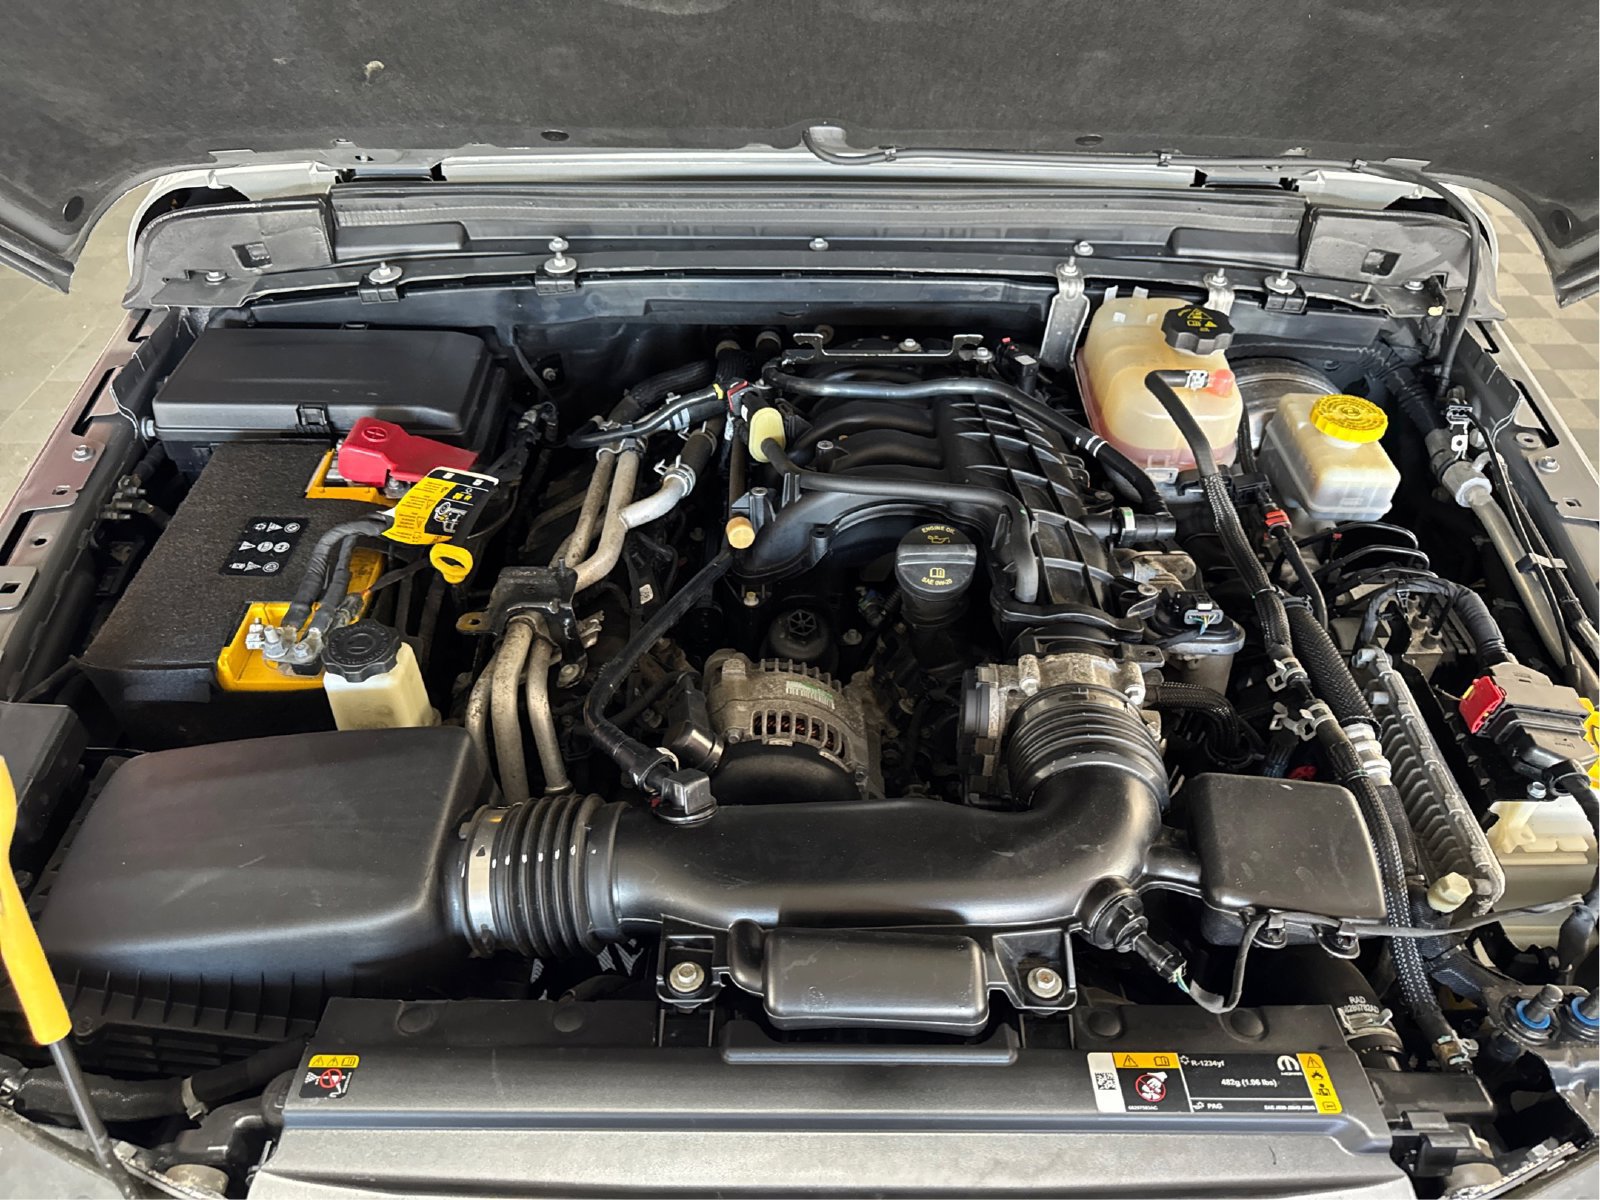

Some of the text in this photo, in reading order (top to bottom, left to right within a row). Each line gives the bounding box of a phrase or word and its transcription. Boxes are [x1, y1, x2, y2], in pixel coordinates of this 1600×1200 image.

[945, 527, 956, 535] OIL
[921, 577, 934, 585] SAE
[1348, 995, 1366, 1004] RAD
[1190, 1060, 1225, 1068] R-1234yf
[1220, 1078, 1242, 1088] 482g
[1261, 1078, 1278, 1088] lbs)
[1206, 1102, 1224, 1110] PAG
